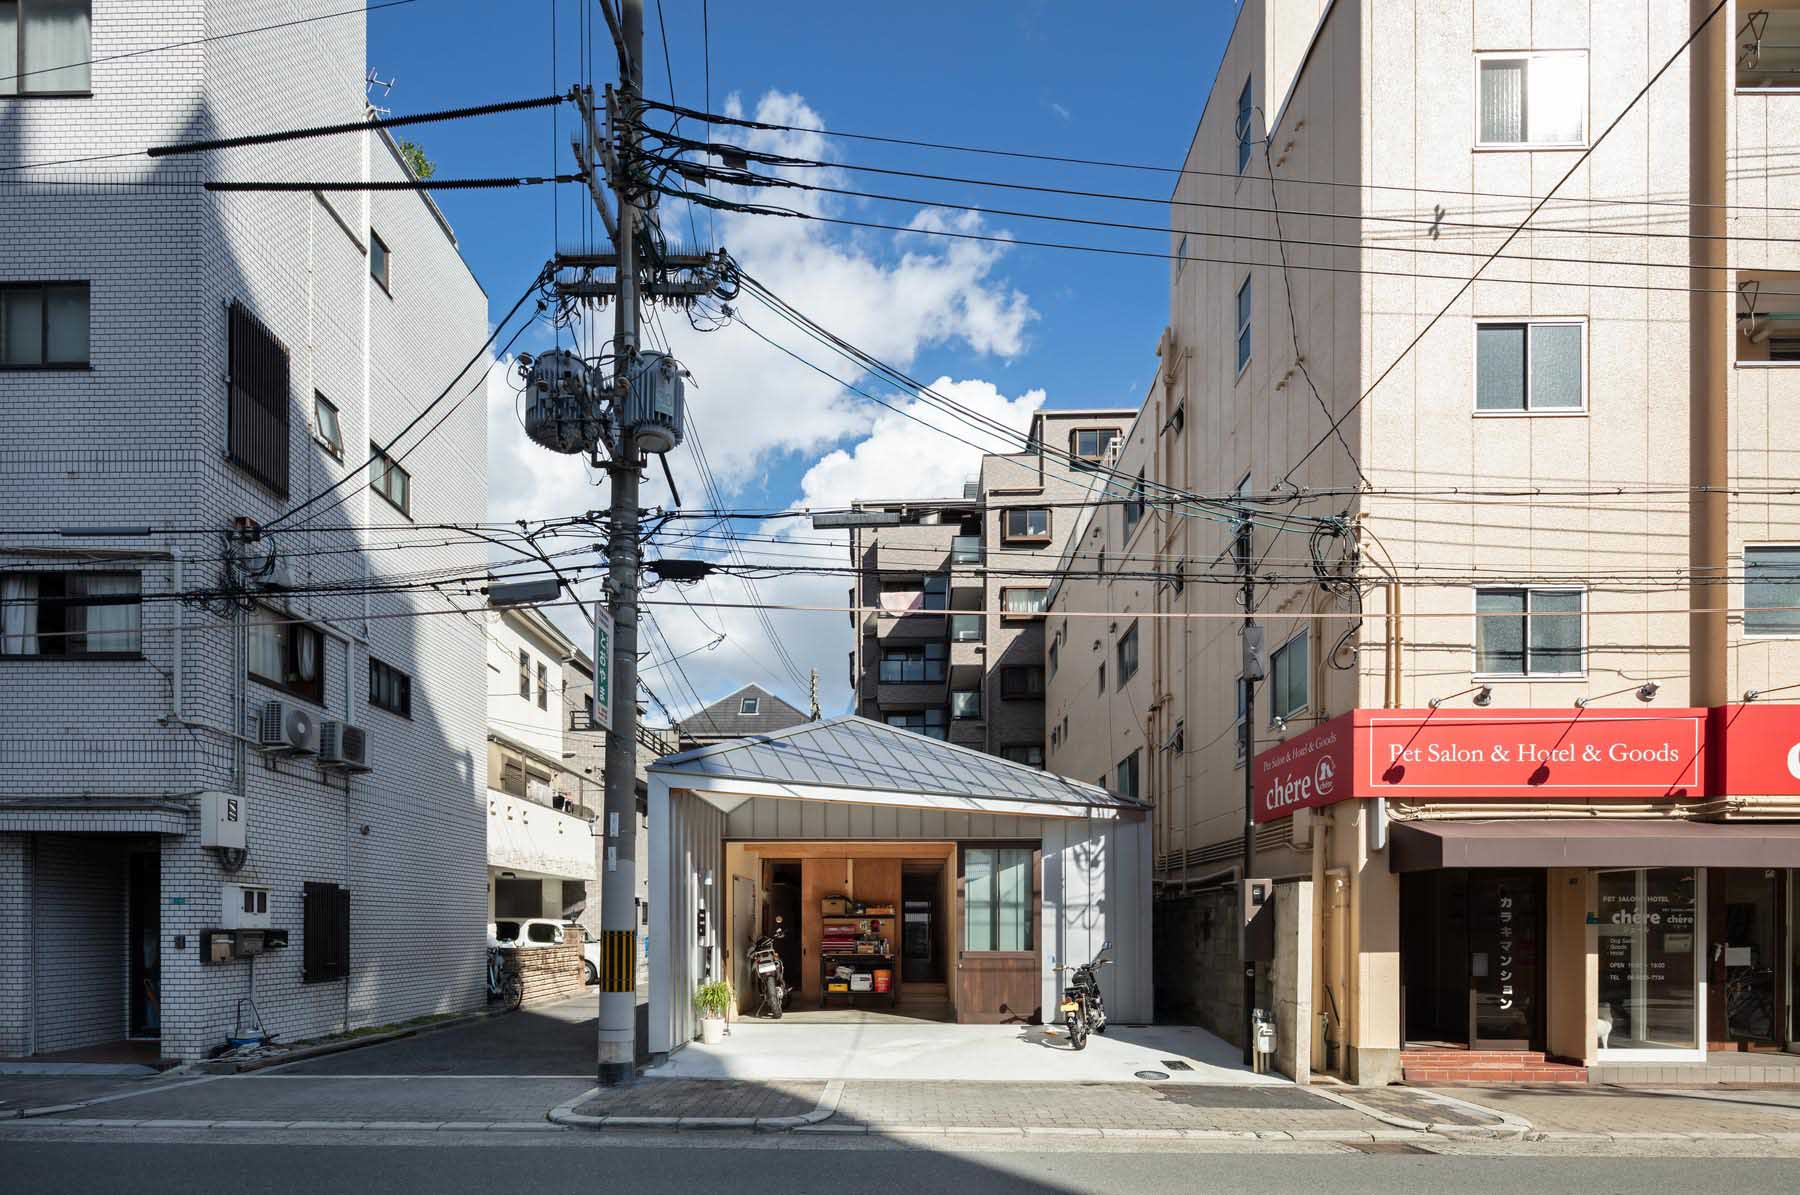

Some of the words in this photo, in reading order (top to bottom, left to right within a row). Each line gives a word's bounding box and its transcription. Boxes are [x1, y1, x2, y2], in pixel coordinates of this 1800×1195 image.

[1286, 751, 1292, 762] &
[1292, 743, 1308, 760] Hotel
[1308, 743, 1314, 753] &
[1315, 732, 1337, 749] Goods
[1389, 743, 1421, 763] Pet
[1427, 742, 1484, 763] Salon
[1490, 744, 1511, 763] &
[1518, 742, 1576, 763] Hotel
[1582, 743, 1602, 763] &
[1608, 742, 1679, 763] Goods
[1266, 773, 1311, 810] chére
[1612, 908, 1661, 925] chére
[1666, 914, 1694, 924] chére
[1500, 897, 1513, 1010] カラキマンション
